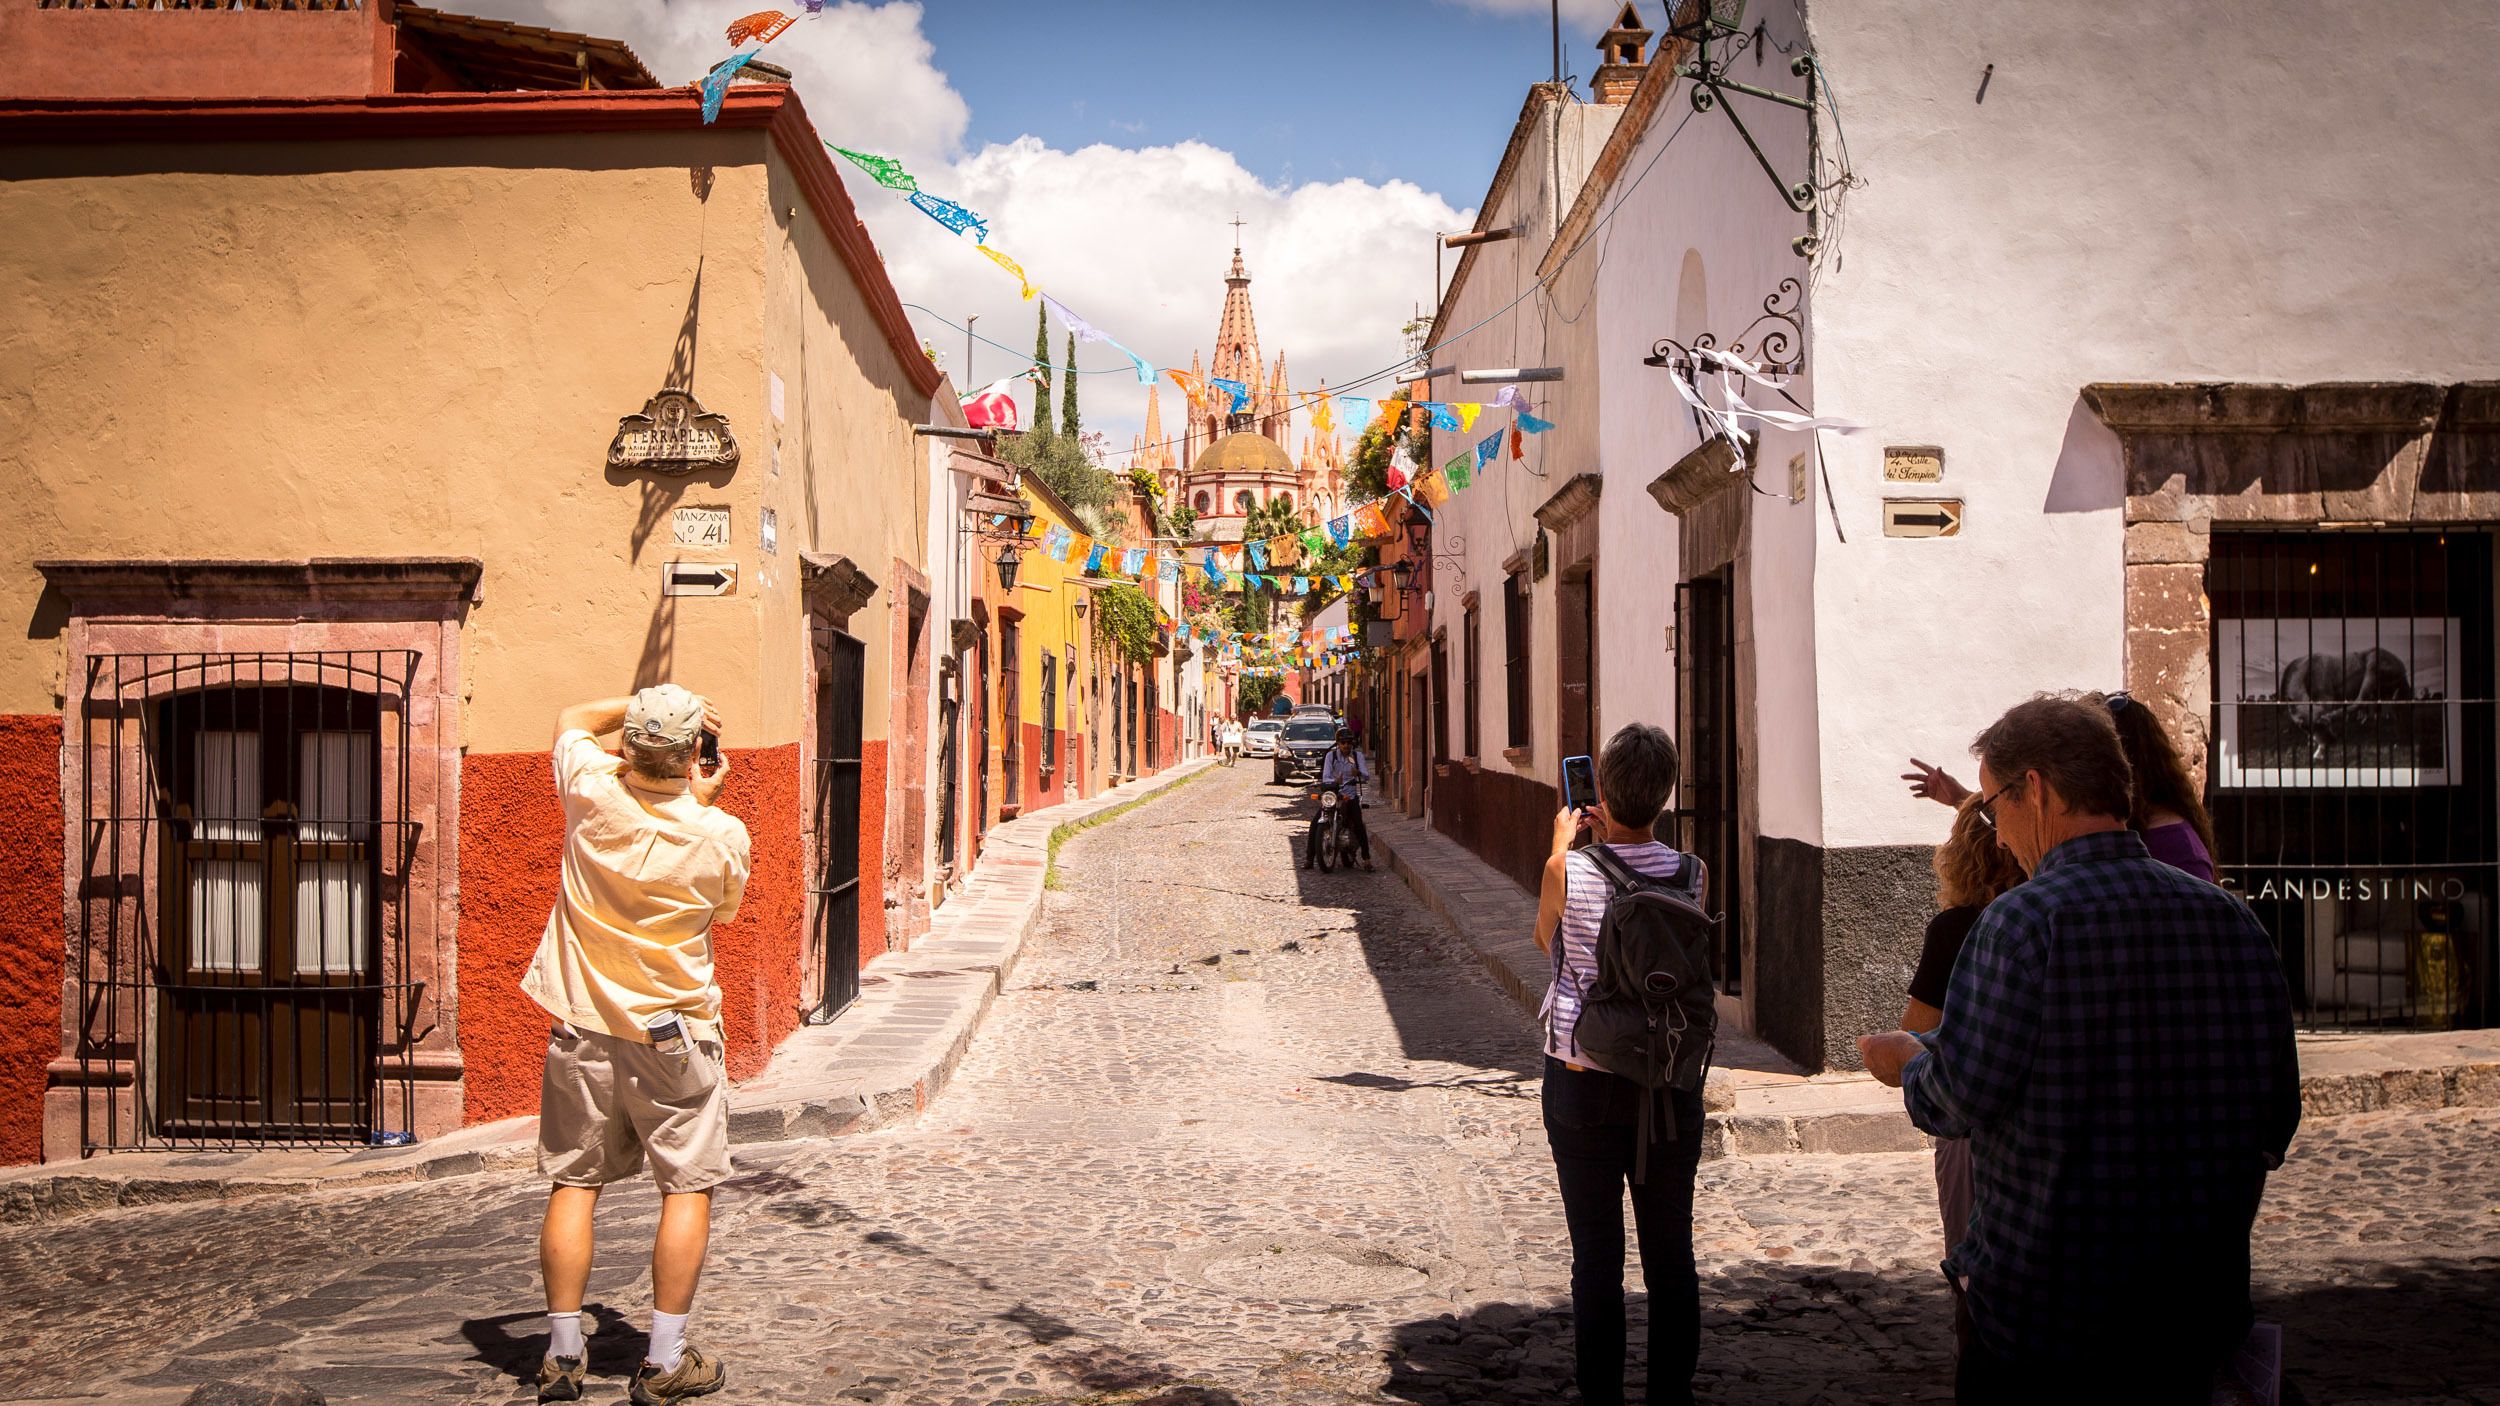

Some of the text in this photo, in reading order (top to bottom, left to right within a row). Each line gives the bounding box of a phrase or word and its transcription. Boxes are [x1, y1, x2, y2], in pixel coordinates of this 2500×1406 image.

[632, 429, 717, 443] TERRAPLEN
[1907, 453, 1931, 465] Calle
[672, 509, 728, 521] MANZANA
[2219, 878, 2465, 900] CANDESTINO
